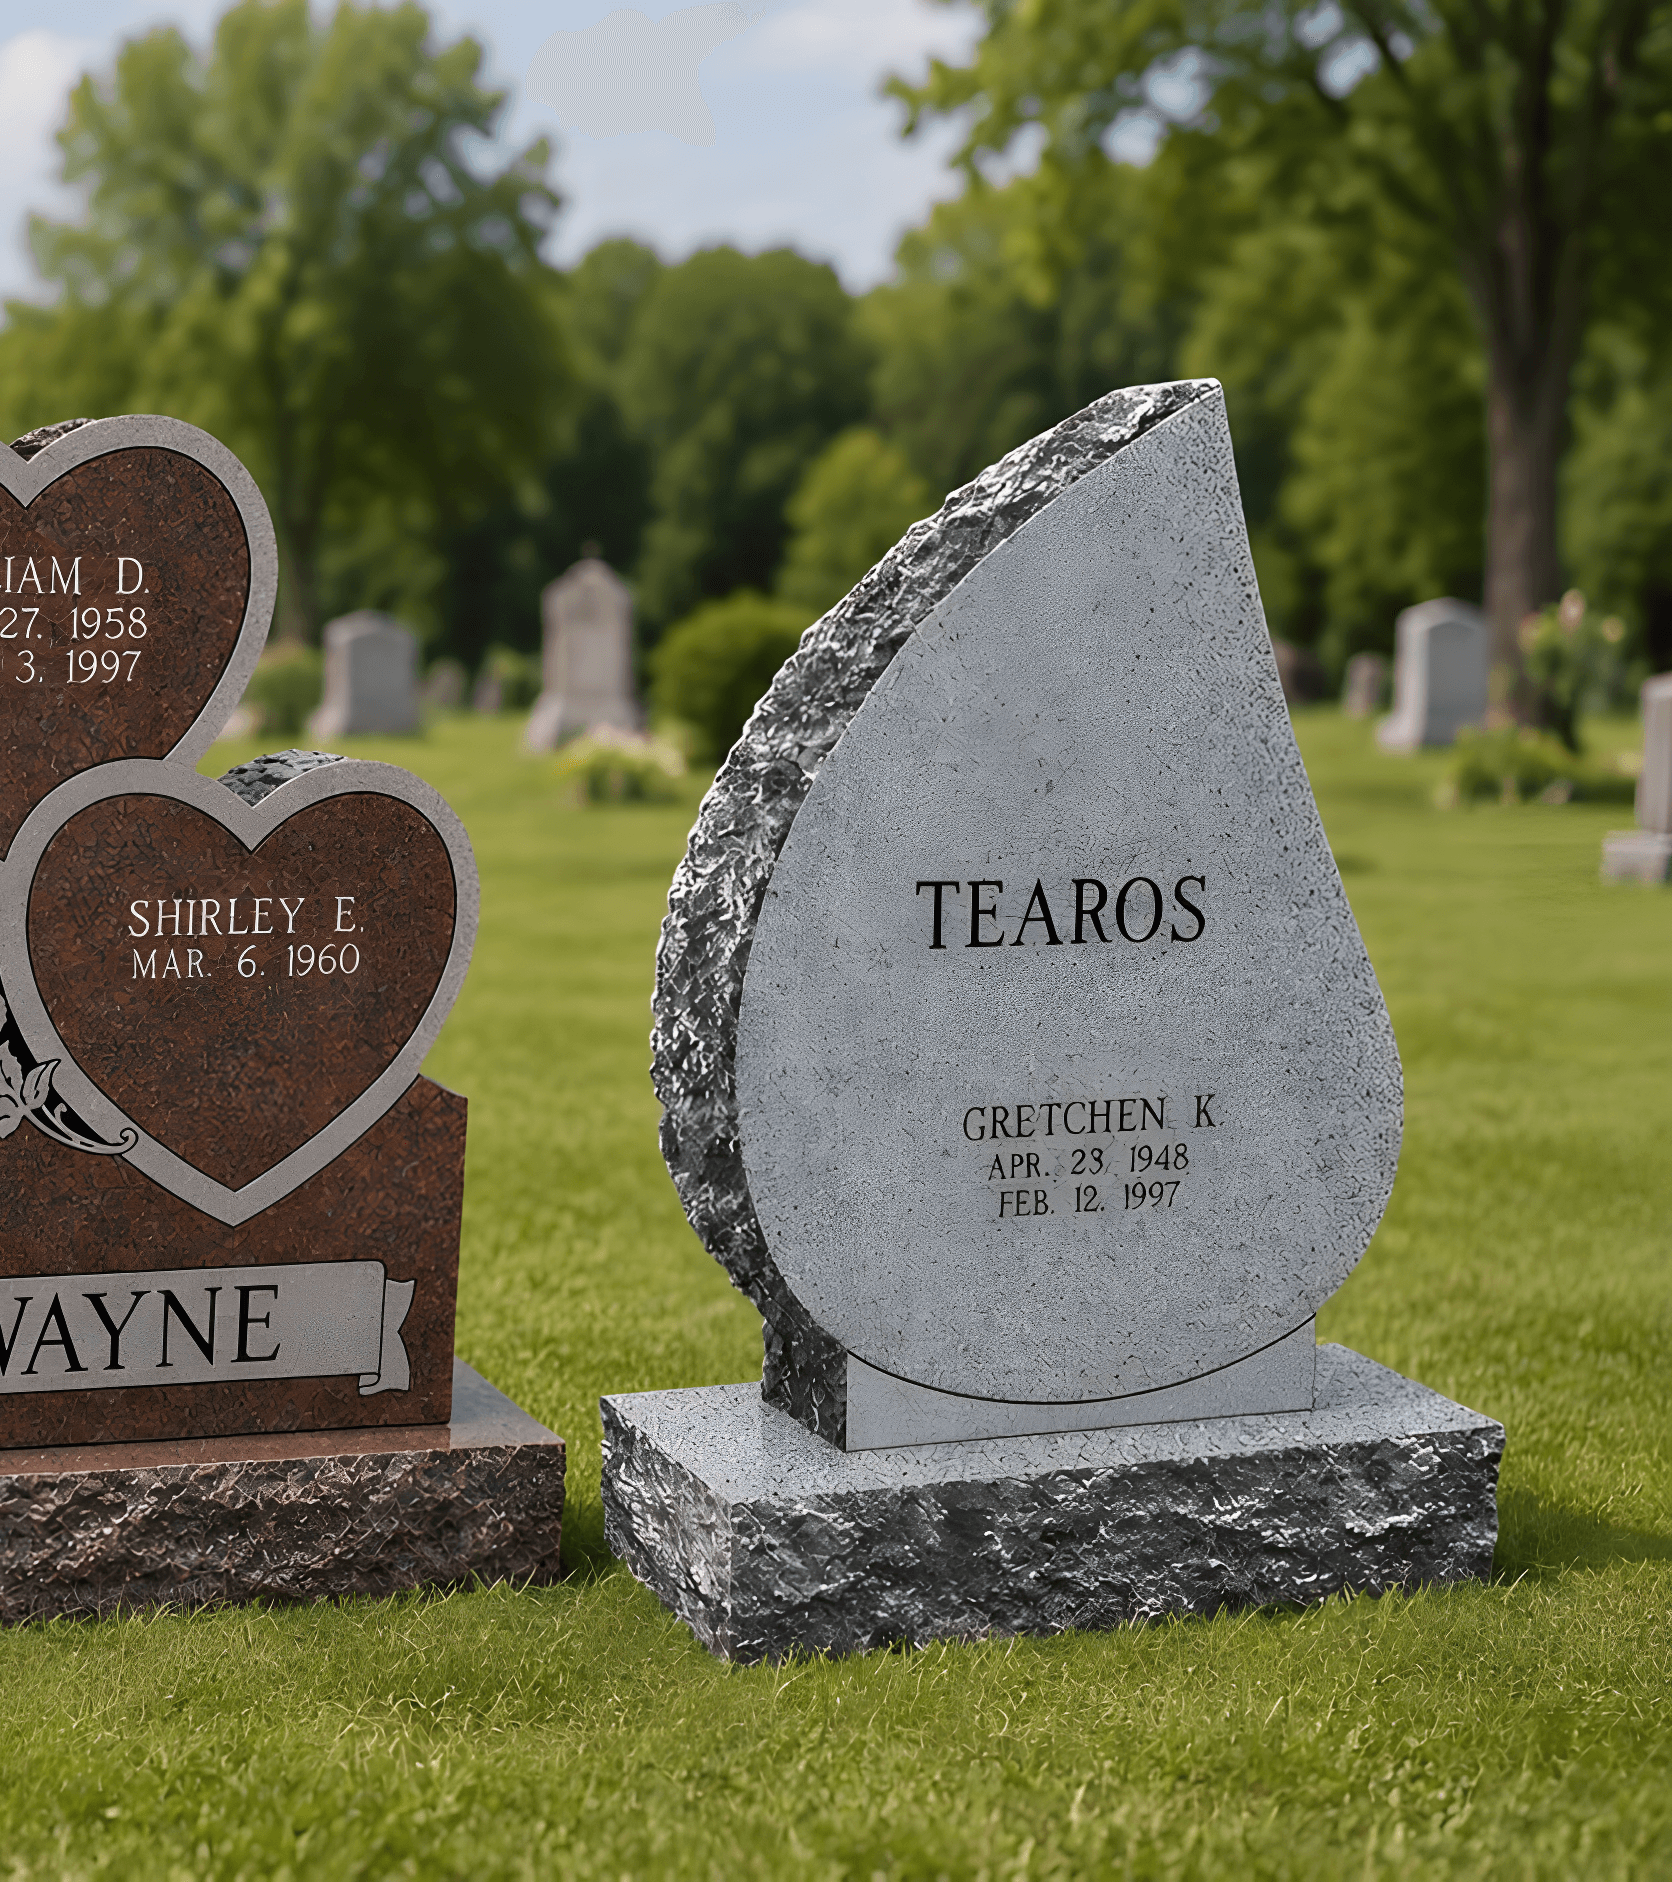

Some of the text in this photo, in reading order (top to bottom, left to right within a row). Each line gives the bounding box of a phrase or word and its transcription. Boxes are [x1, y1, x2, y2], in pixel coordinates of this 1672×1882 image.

[115, 557, 150, 596] D.
[0, 607, 43, 639] 27.
[71, 606, 148, 640] 1958
[66, 649, 142, 684] 1997
[128, 897, 305, 938] SHIRLEY
[915, 875, 1206, 950] TEAROS
[132, 943, 360, 979] MAR. 6. 1960
[962, 1097, 1168, 1141] GRETCHEN
[988, 1152, 1050, 1181] APR.
[1130, 1143, 1189, 1172] 1948
[999, 1181, 1181, 1218] FEB. 12. 1997
